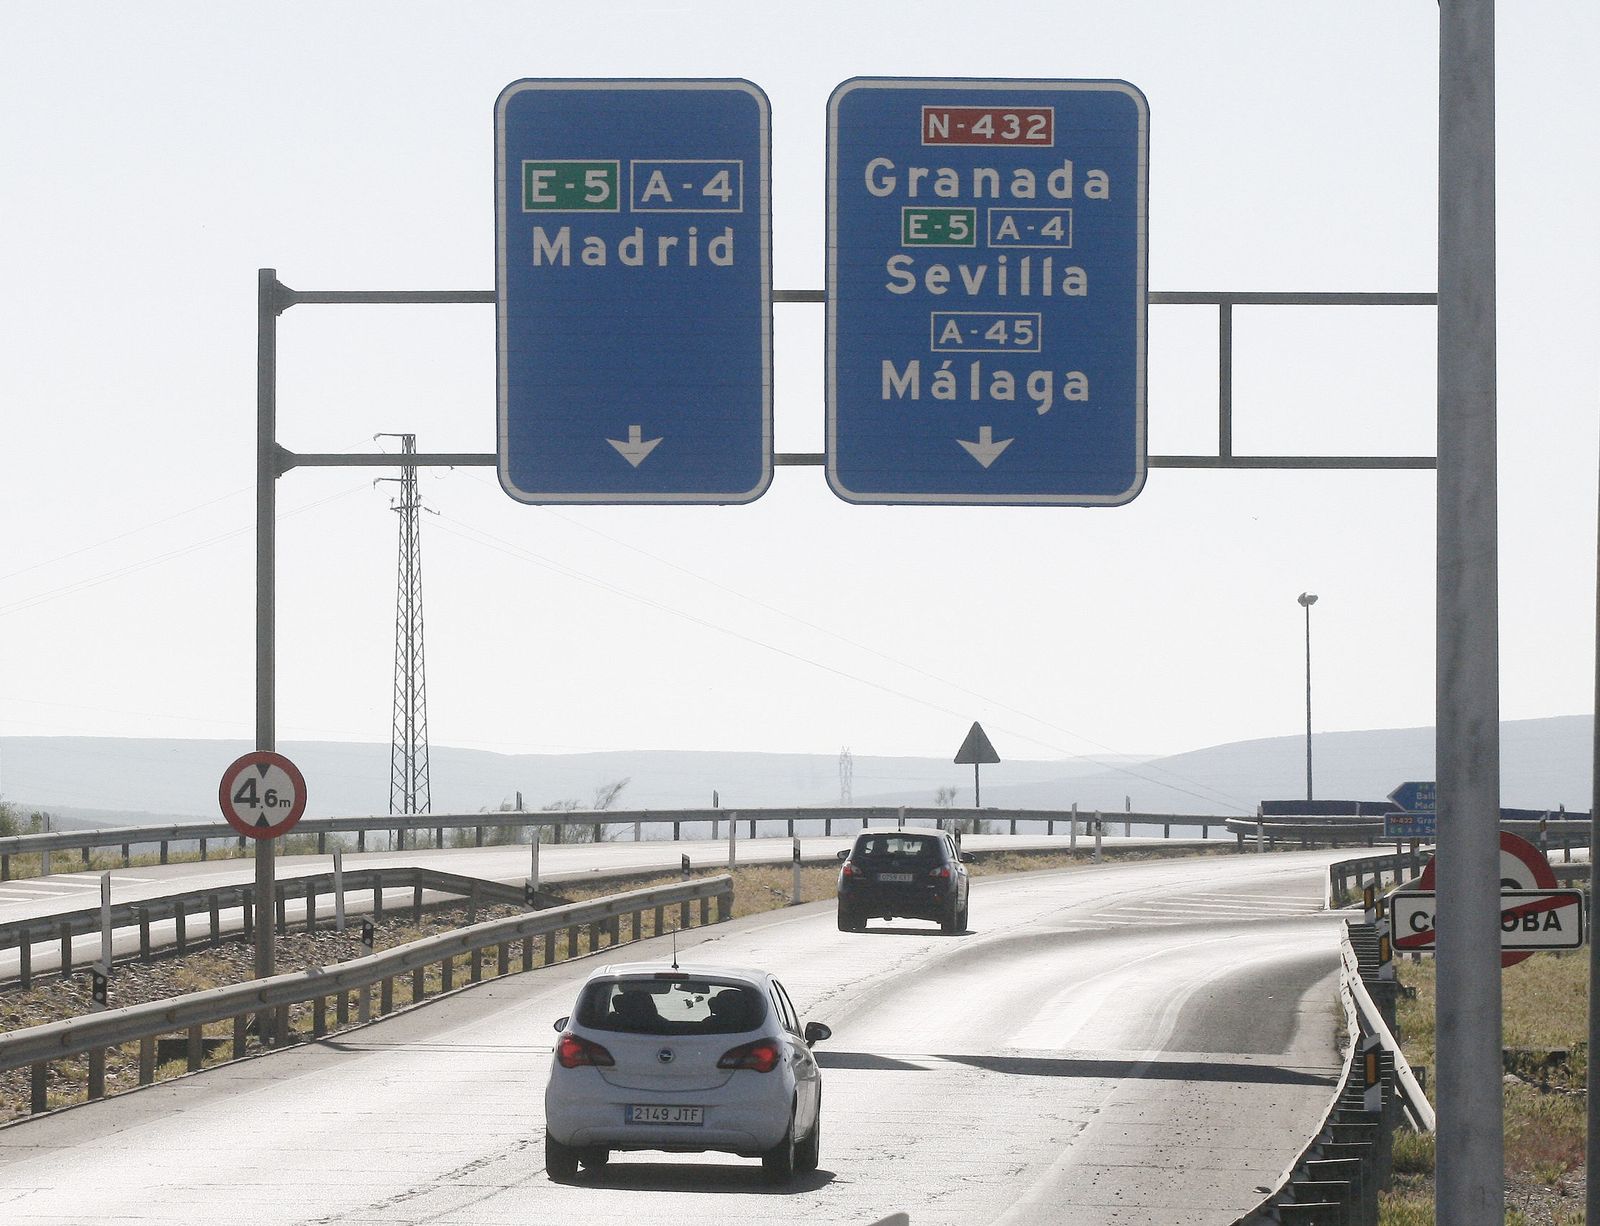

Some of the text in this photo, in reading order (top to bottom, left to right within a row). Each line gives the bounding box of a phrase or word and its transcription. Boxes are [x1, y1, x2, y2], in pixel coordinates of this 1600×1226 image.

[927, 113, 1048, 140] N-432
[531, 169, 734, 203] E-5 A-4
[863, 156, 1111, 200] Granada
[908, 214, 1066, 241] E-5 A-4
[531, 225, 736, 267] Madrid
[884, 254, 1089, 297] Sevilla
[938, 319, 1035, 345] A-45
[881, 359, 1091, 416] Málaga
[1409, 910, 1563, 932] COBA
[634, 1108, 699, 1122] 2149 JTF
